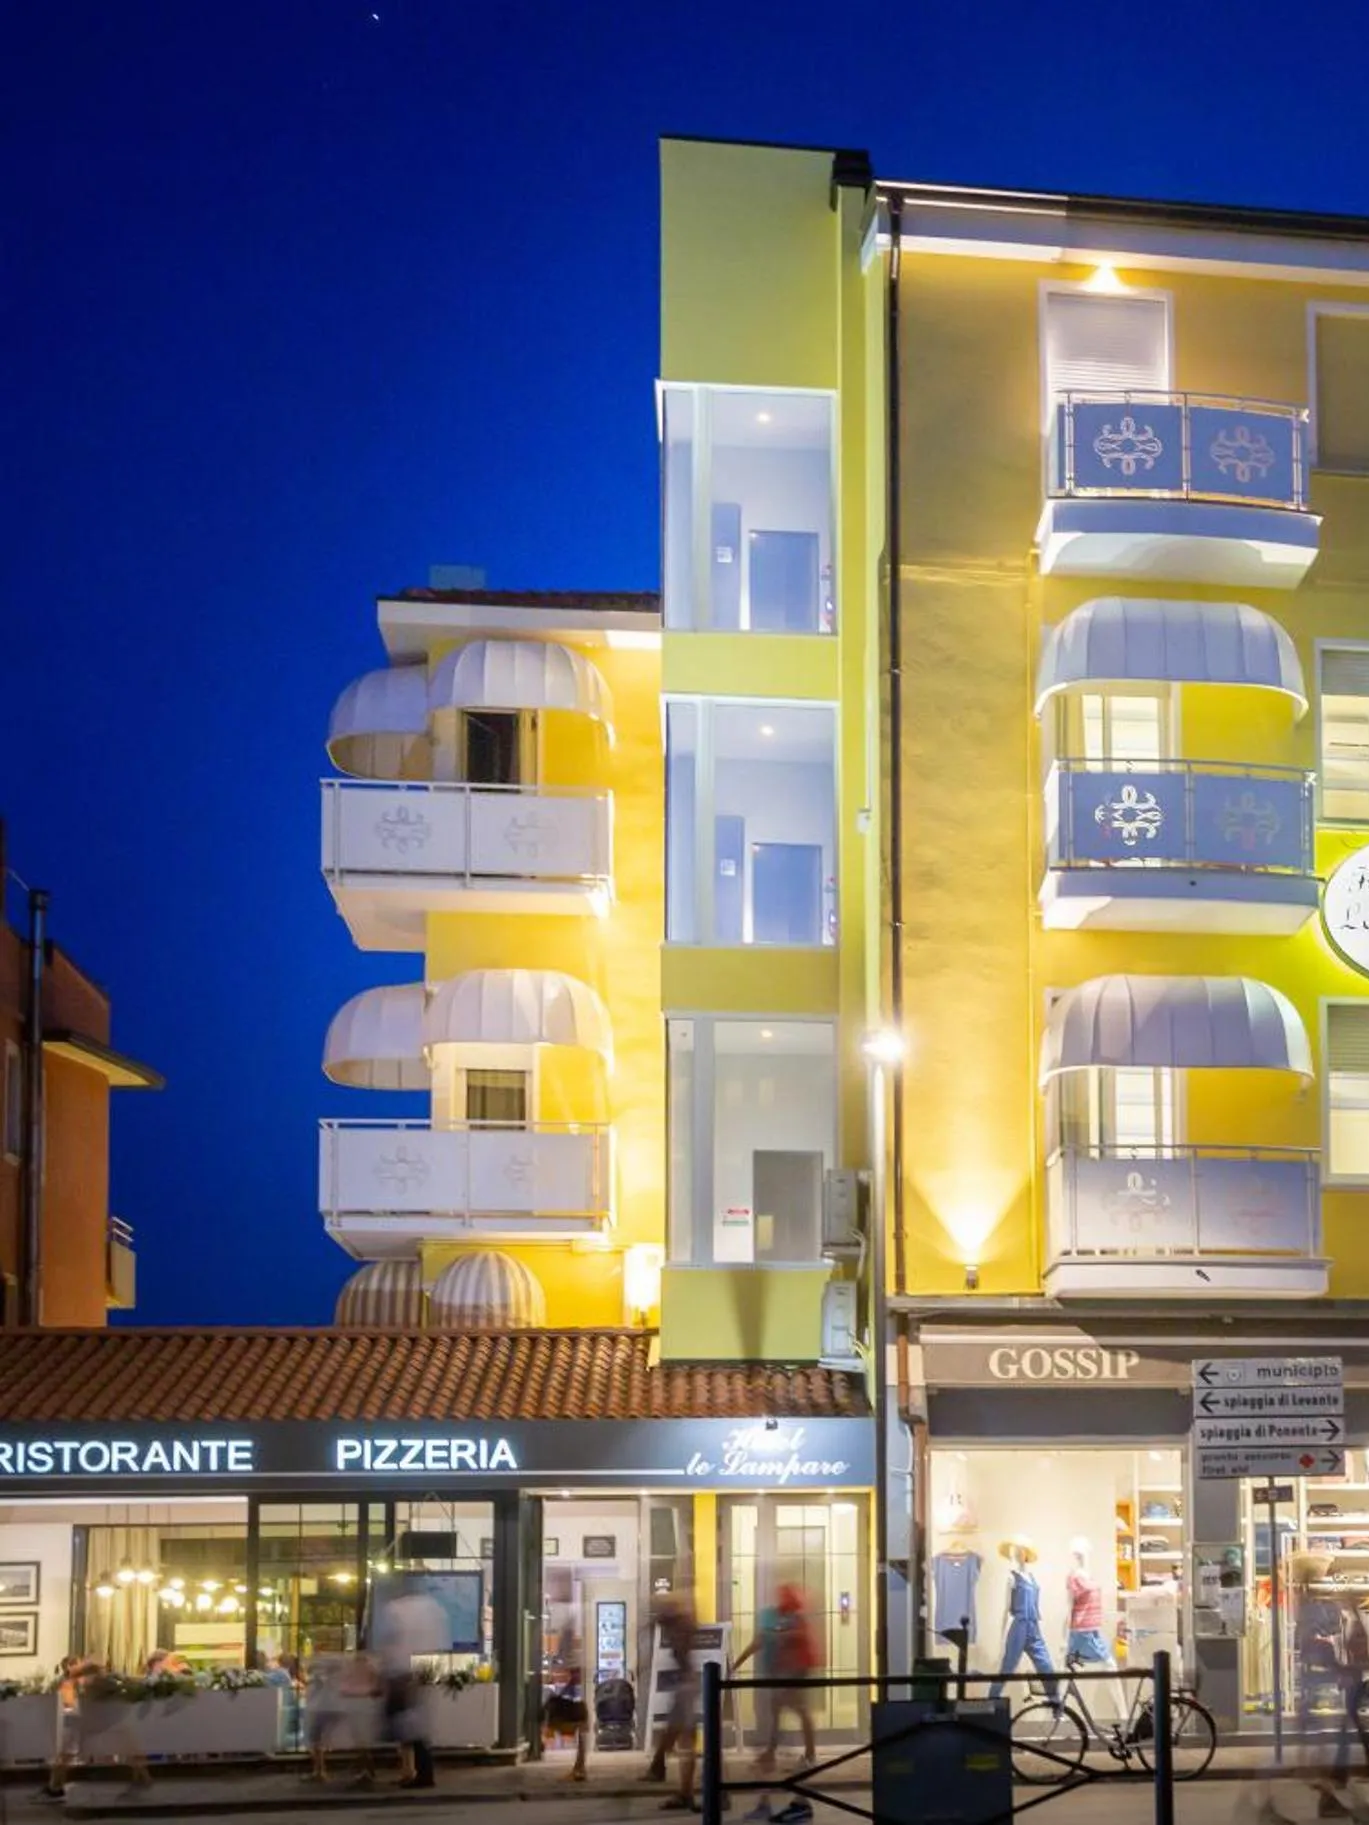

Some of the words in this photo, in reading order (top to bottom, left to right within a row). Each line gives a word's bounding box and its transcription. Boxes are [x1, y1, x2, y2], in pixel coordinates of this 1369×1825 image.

[989, 1348, 1140, 1379] GOSSIP
[1257, 1365, 1340, 1380] municipio
[1224, 1394, 1275, 1410] spiaggia
[1278, 1393, 1290, 1407] di
[1292, 1393, 1339, 1407] Levante
[1201, 1424, 1251, 1441] spiaggia
[1255, 1424, 1266, 1437] di
[1269, 1423, 1318, 1437] Ponente
[0, 1441, 254, 1473] RISTORANTE
[336, 1438, 518, 1470] PIZZERIA
[687, 1452, 715, 1476] le
[719, 1451, 851, 1484] Lampare
